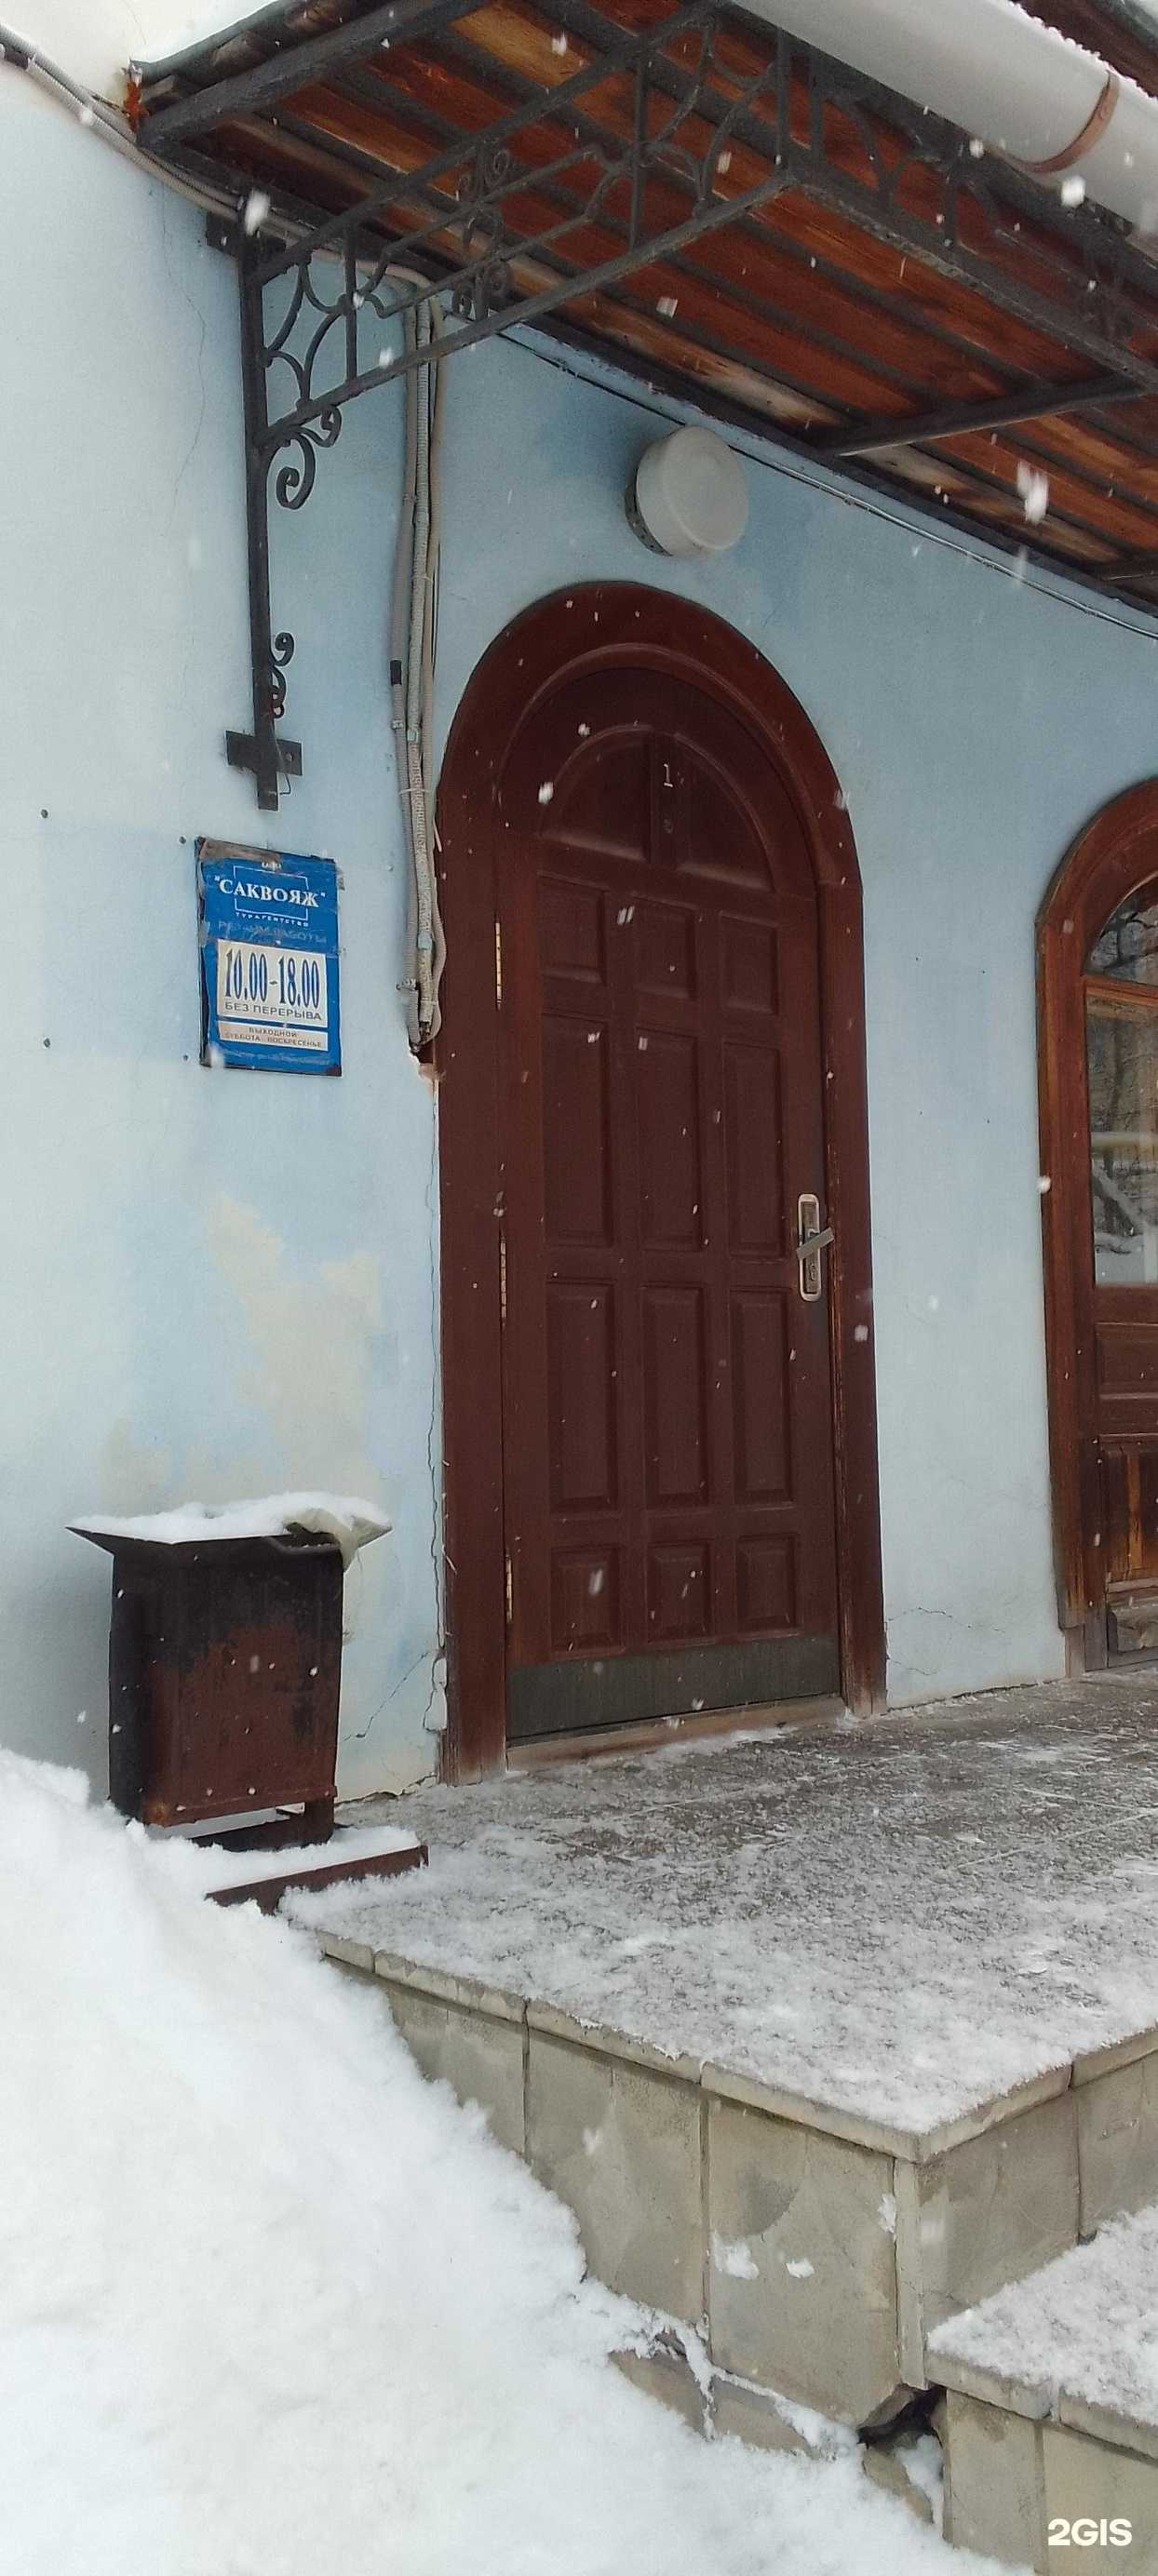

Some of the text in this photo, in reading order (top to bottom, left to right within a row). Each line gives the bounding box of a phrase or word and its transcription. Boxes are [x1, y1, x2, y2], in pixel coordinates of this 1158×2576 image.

[663, 763, 674, 788] 1
[224, 1001, 322, 1021] БЕЗ ПЕРЕРЫВА
